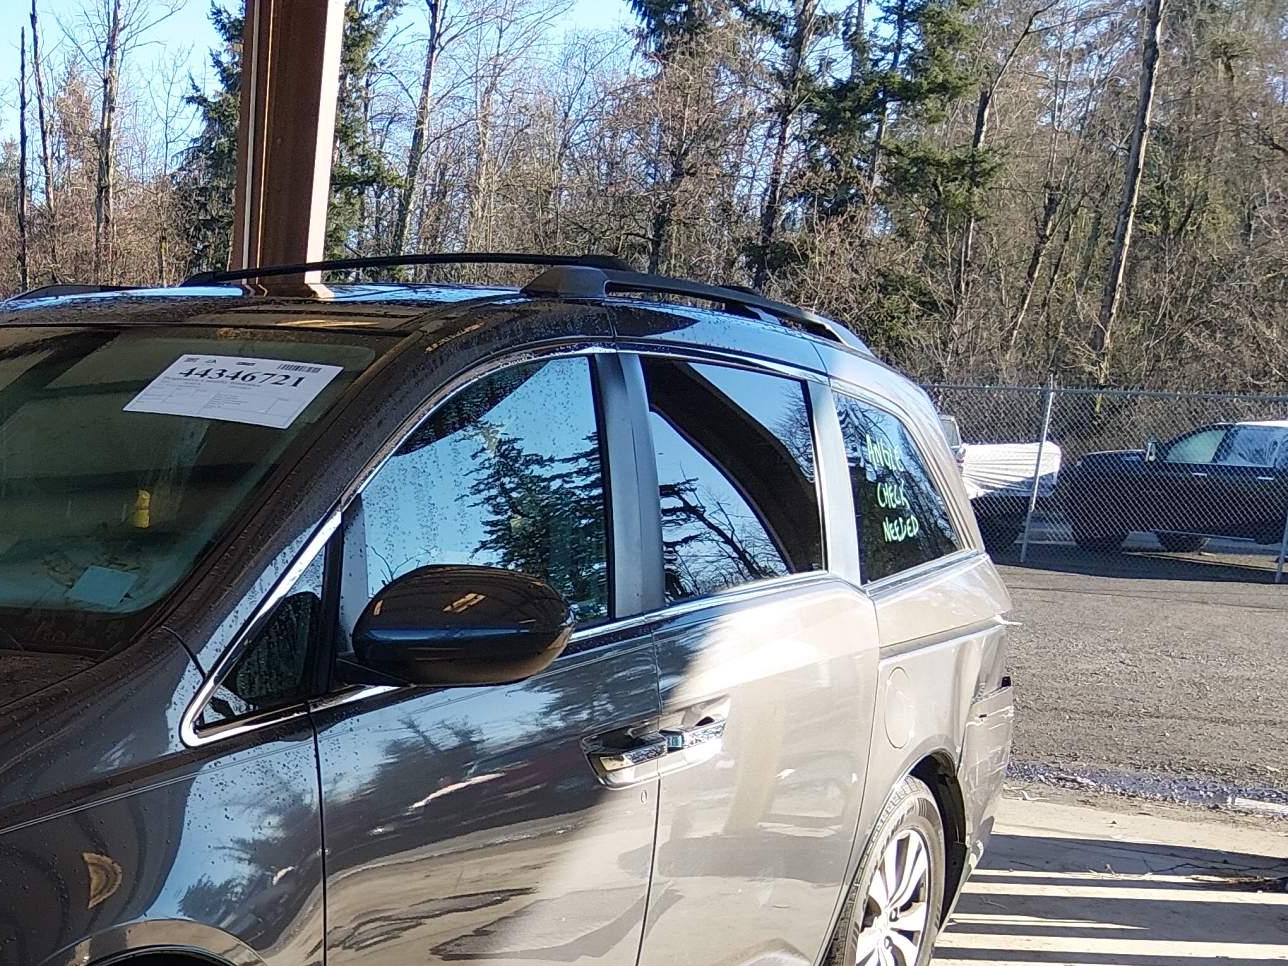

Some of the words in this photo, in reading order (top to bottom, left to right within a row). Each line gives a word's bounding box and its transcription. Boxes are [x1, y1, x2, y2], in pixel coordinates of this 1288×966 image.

[178, 367, 305, 387] 44346721
[876, 479, 911, 510] CHECK
[882, 514, 920, 543] NEEDED
